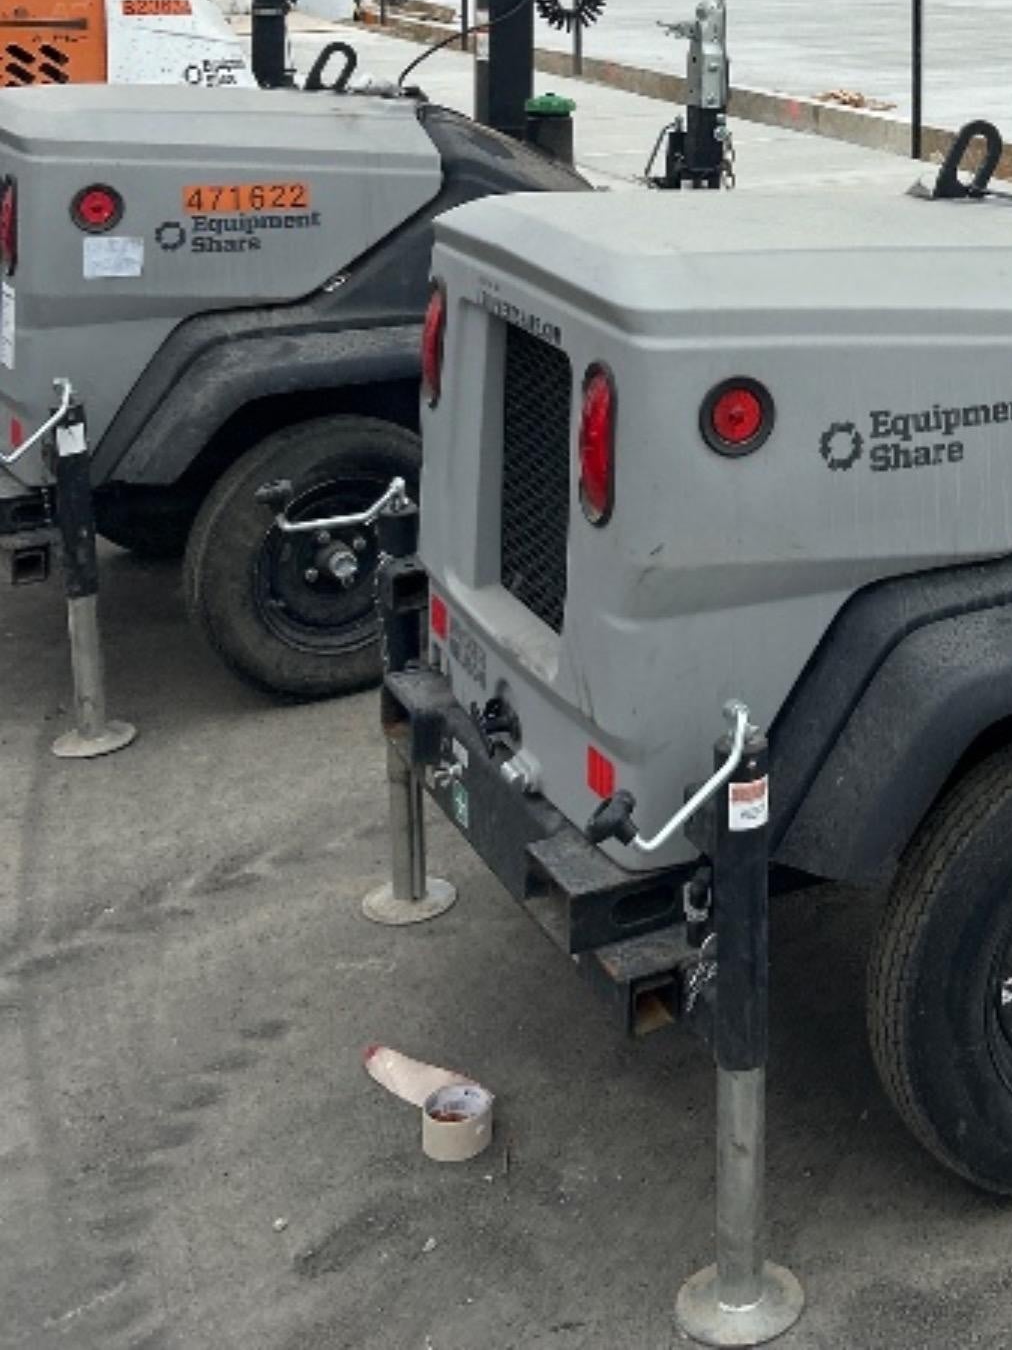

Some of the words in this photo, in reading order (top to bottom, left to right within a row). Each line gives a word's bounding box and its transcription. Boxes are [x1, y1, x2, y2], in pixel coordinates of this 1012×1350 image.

[186, 184, 307, 211] 471622
[191, 211, 321, 234] Equipment
[191, 236, 262, 252] Share
[869, 440, 964, 472] Share
